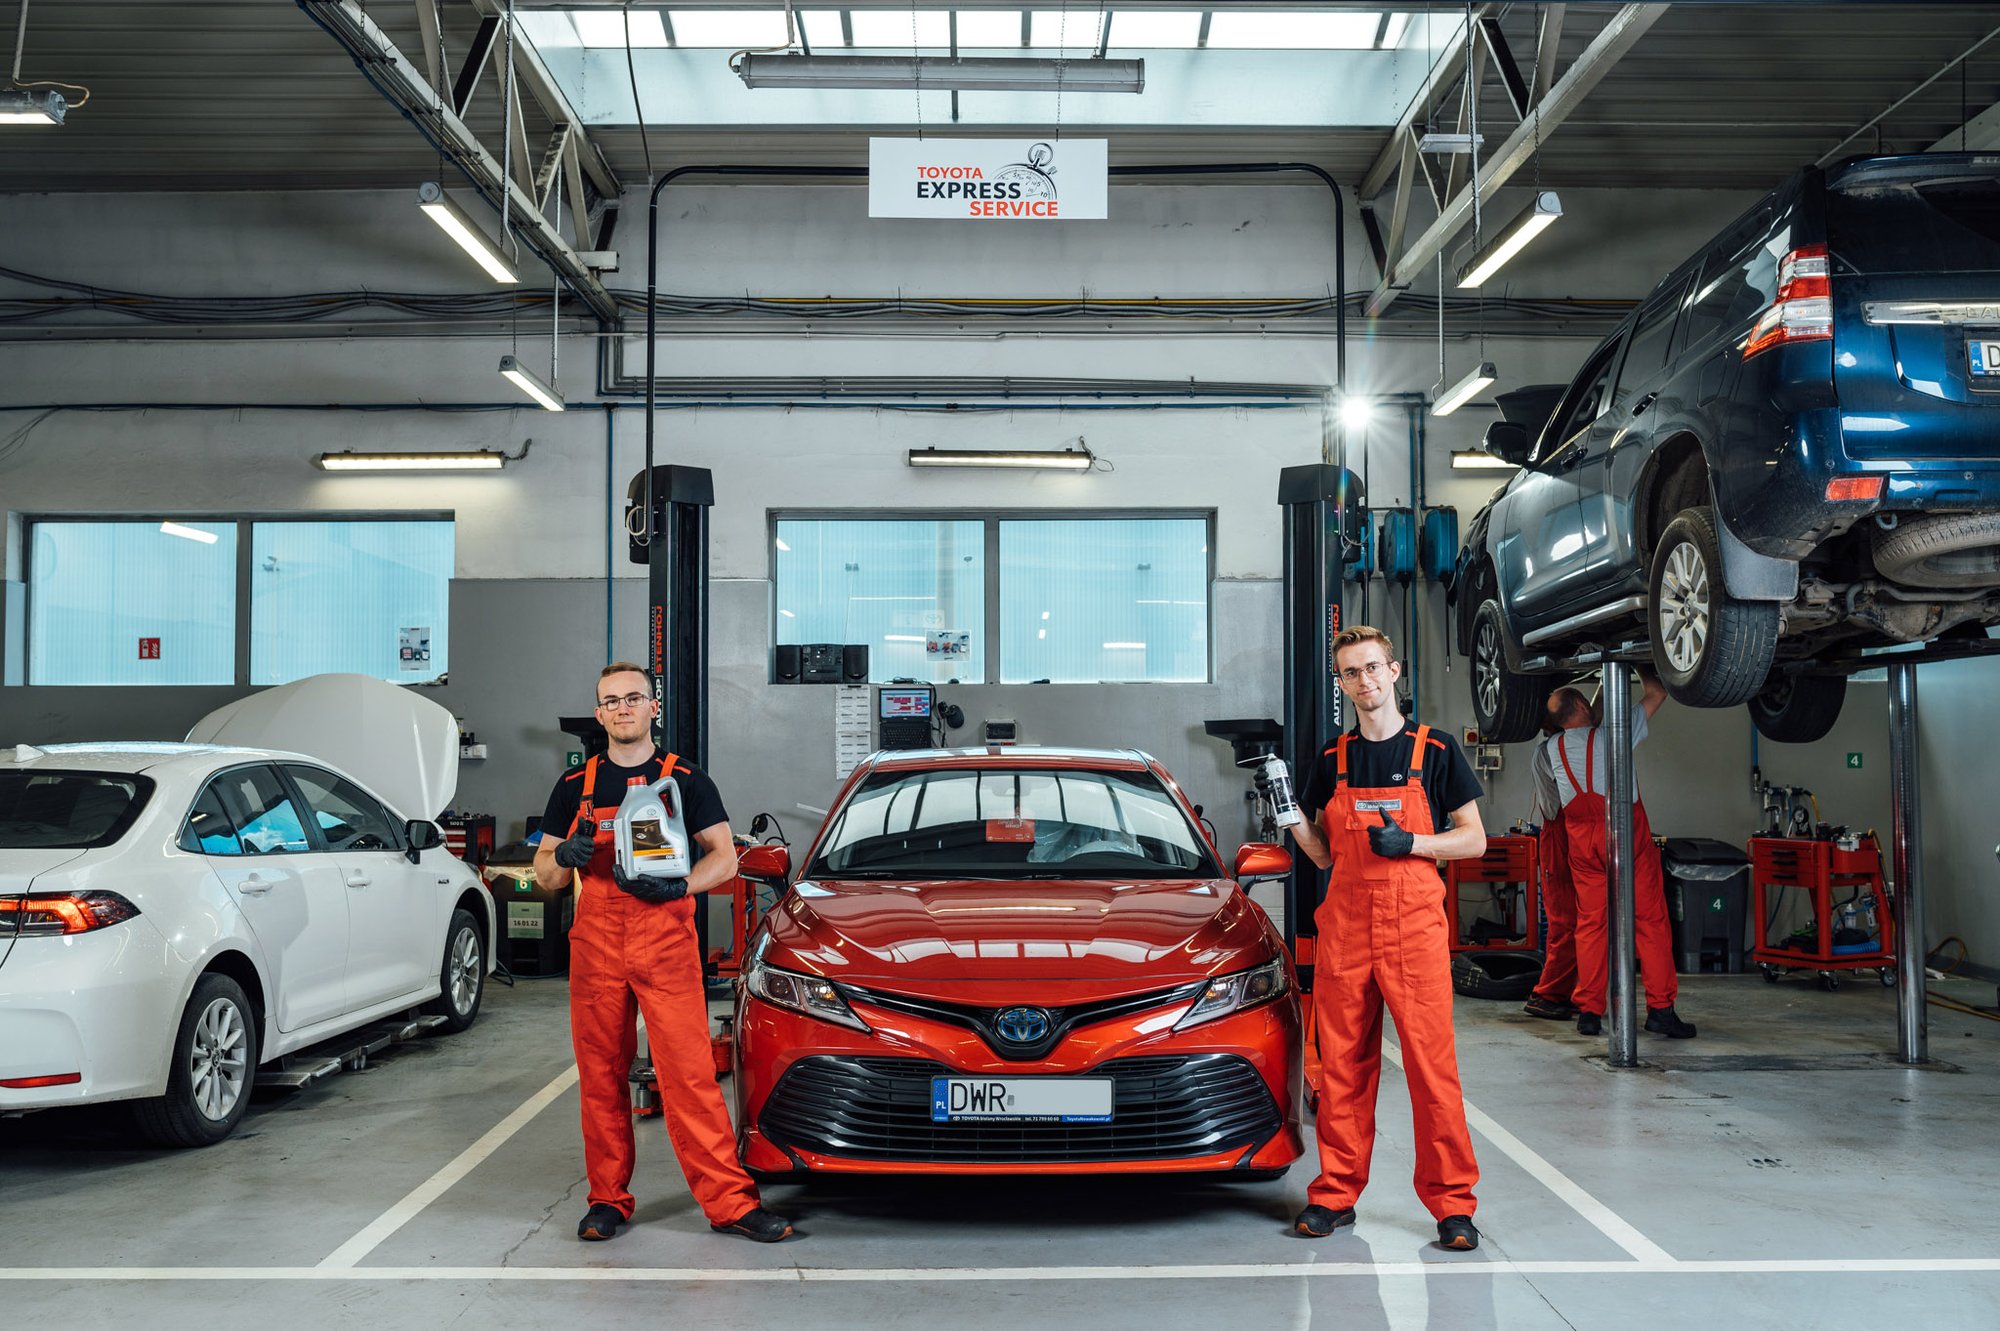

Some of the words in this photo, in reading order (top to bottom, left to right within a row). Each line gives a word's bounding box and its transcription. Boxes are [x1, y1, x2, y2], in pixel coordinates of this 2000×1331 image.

[917, 166, 983, 179] TOYOTA
[917, 181, 1021, 199] EXPRESS
[969, 201, 1058, 216] SERVICE
[1966, 306, 2000, 318] LA
[1972, 359, 1982, 367] PL
[570, 754, 579, 765] 6
[1850, 755, 1859, 766] 4
[519, 879, 528, 889] 6
[1713, 898, 1721, 910] 4
[951, 1083, 1006, 1112] DWR
[935, 1101, 947, 1110] PL
